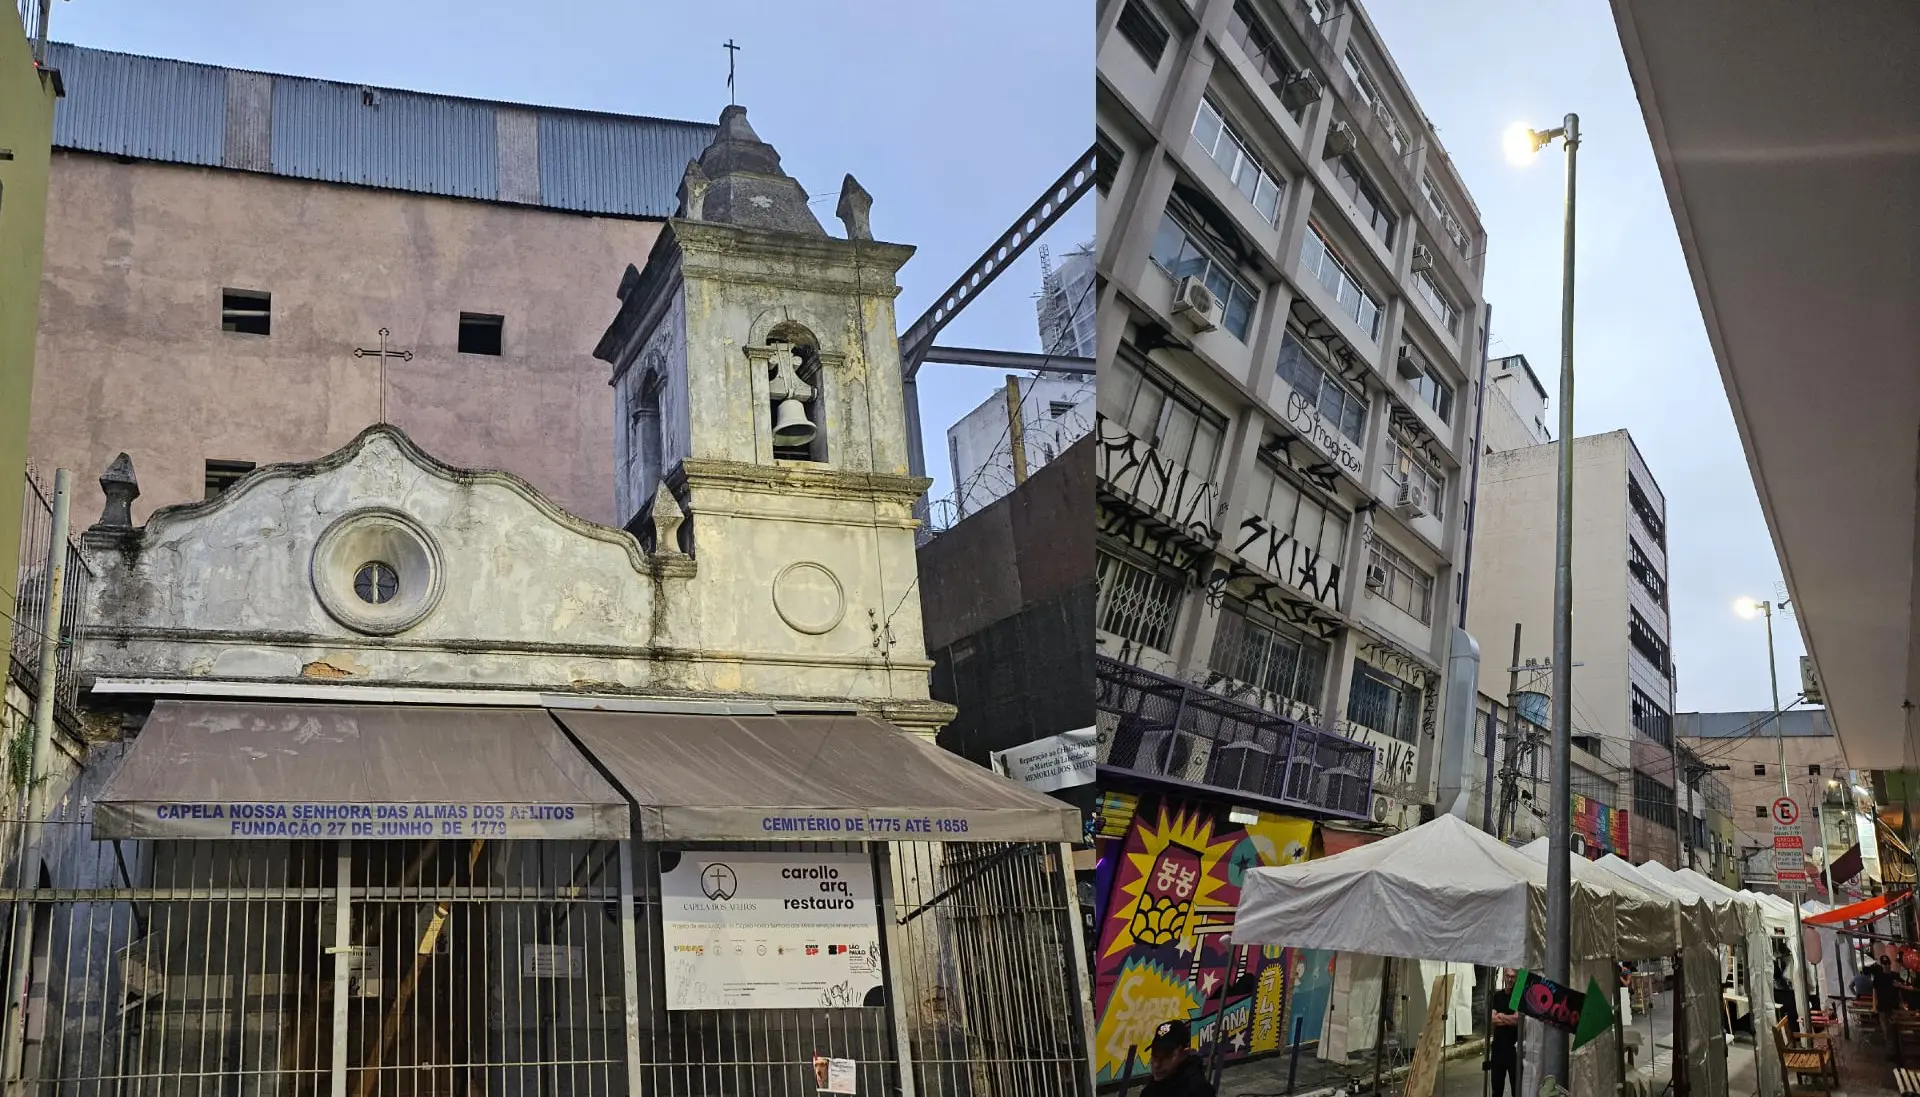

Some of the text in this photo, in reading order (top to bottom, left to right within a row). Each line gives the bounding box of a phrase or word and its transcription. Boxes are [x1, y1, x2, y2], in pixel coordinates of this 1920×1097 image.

[157, 804, 575, 820] CAPELA NOSSA SENHORA DAS ALMAS DOS AFLITOS
[231, 819, 507, 838] FUNDAÇÃO 27 DE JUNHO DE 1779
[762, 814, 968, 833] CEMITÉRIO DE 1775 ATÉ 1858
[781, 866, 838, 880] carollo
[1157, 858, 1196, 898] 봉봉
[784, 895, 854, 910] restauro
[1257, 970, 1277, 1041] ラムネ
[1199, 1005, 1247, 1047] MEONA
